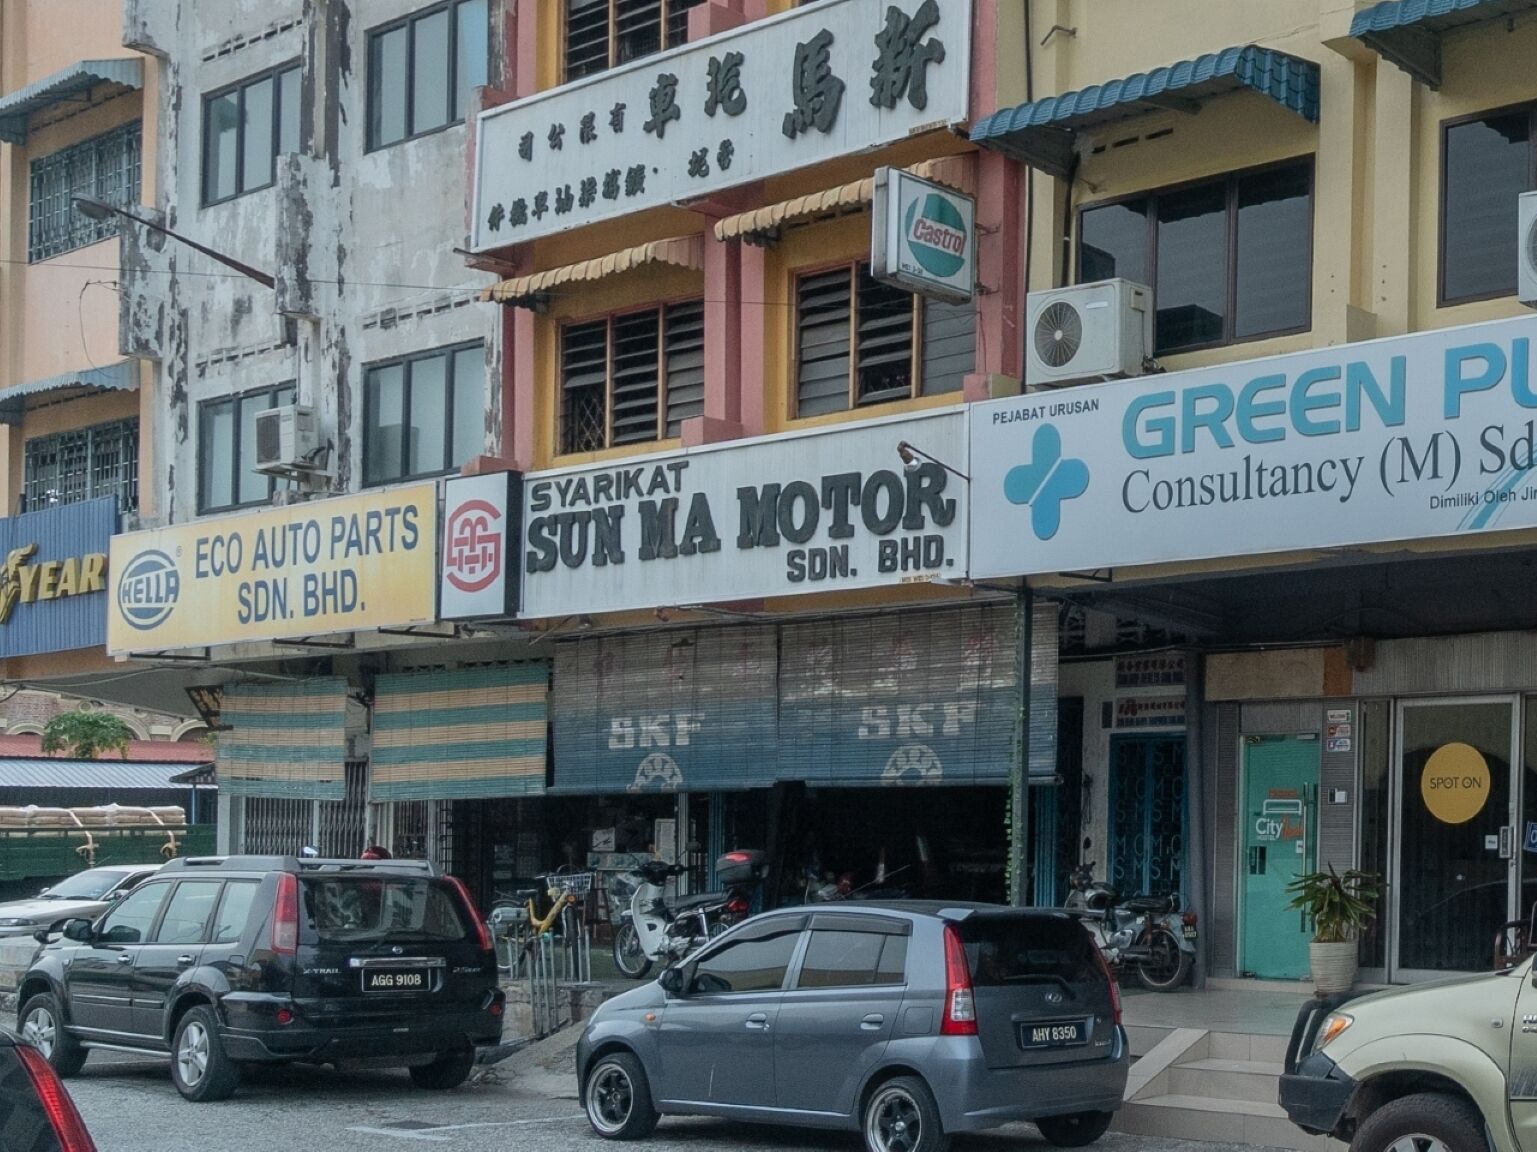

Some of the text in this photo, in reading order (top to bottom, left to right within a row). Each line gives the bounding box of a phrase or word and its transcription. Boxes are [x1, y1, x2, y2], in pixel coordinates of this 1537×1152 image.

[913, 217, 967, 257] Castrol
[992, 398, 1100, 426] PEJABAT URUSAN
[1120, 355, 1407, 460] GREEN
[530, 460, 690, 513] SYARIKAT
[1121, 448, 1366, 515] Consultancy
[1378, 429, 1462, 495] (M)
[526, 504, 626, 575] SUN
[637, 492, 722, 562] MA
[736, 461, 957, 550] MOTOR
[1429, 491, 1479, 510] Dimiliki
[1484, 488, 1517, 504] Oleh
[194, 532, 243, 579] ECO
[251, 519, 321, 572] AUTO
[329, 504, 420, 560] PARTS
[786, 534, 955, 583] SDN. BHD.
[18, 552, 107, 603] YEAR
[121, 568, 180, 605] HELLA
[237, 567, 366, 625] SDN. BHD.
[607, 711, 706, 751] SKF
[858, 701, 977, 740] SKF
[1430, 776, 1482, 790] SPOT ON
[1255, 817, 1284, 839] City
[370, 973, 422, 987] AGG 9108
[1032, 1025, 1078, 1042] AHY 8350
